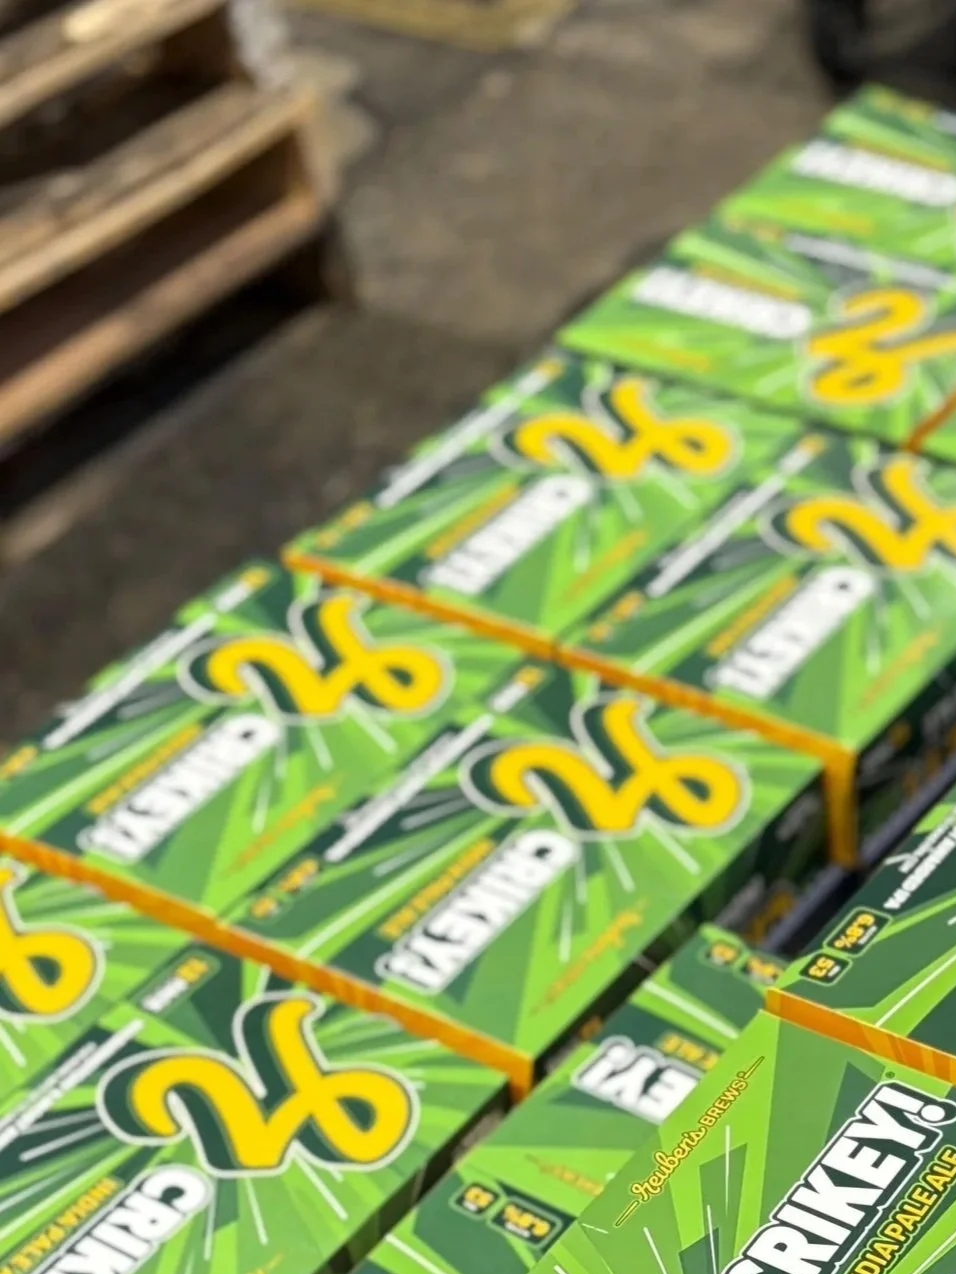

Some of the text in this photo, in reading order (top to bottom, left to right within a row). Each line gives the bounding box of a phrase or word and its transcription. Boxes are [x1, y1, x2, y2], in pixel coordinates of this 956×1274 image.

[701, 1079, 748, 1129] BREWS
[886, 1187, 937, 1243] PALE
[8, 1220, 67, 1274] PALE
